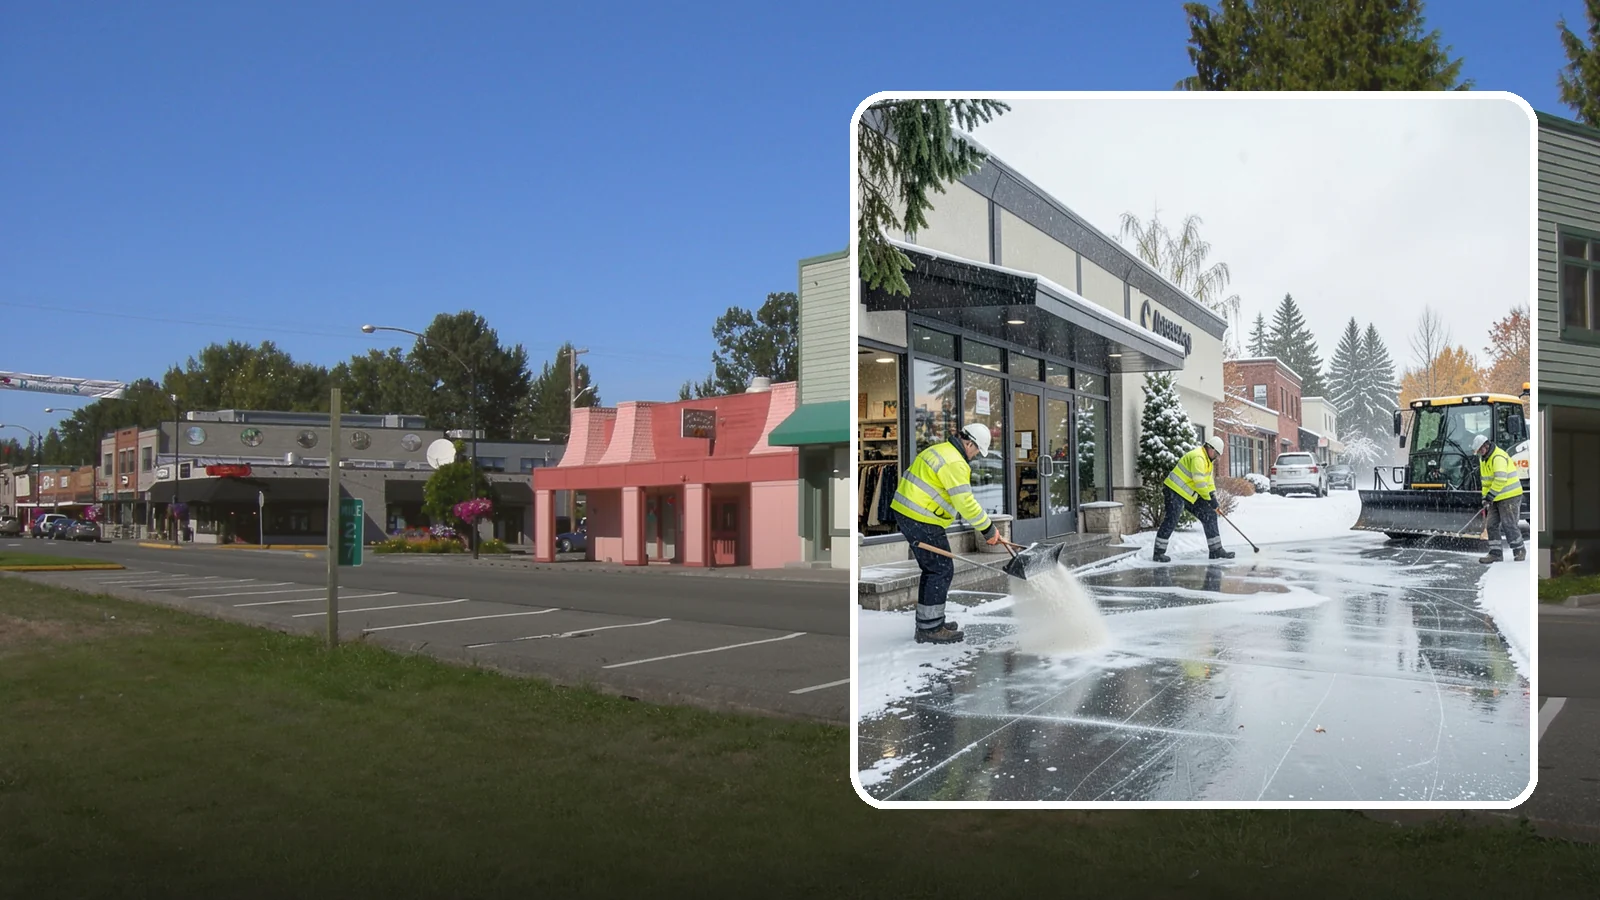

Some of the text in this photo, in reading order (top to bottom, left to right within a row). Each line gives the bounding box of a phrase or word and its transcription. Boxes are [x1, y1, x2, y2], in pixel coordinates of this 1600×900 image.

[341, 505, 362, 517] MILE
[344, 522, 357, 539] 2
[344, 543, 356, 559] 7
